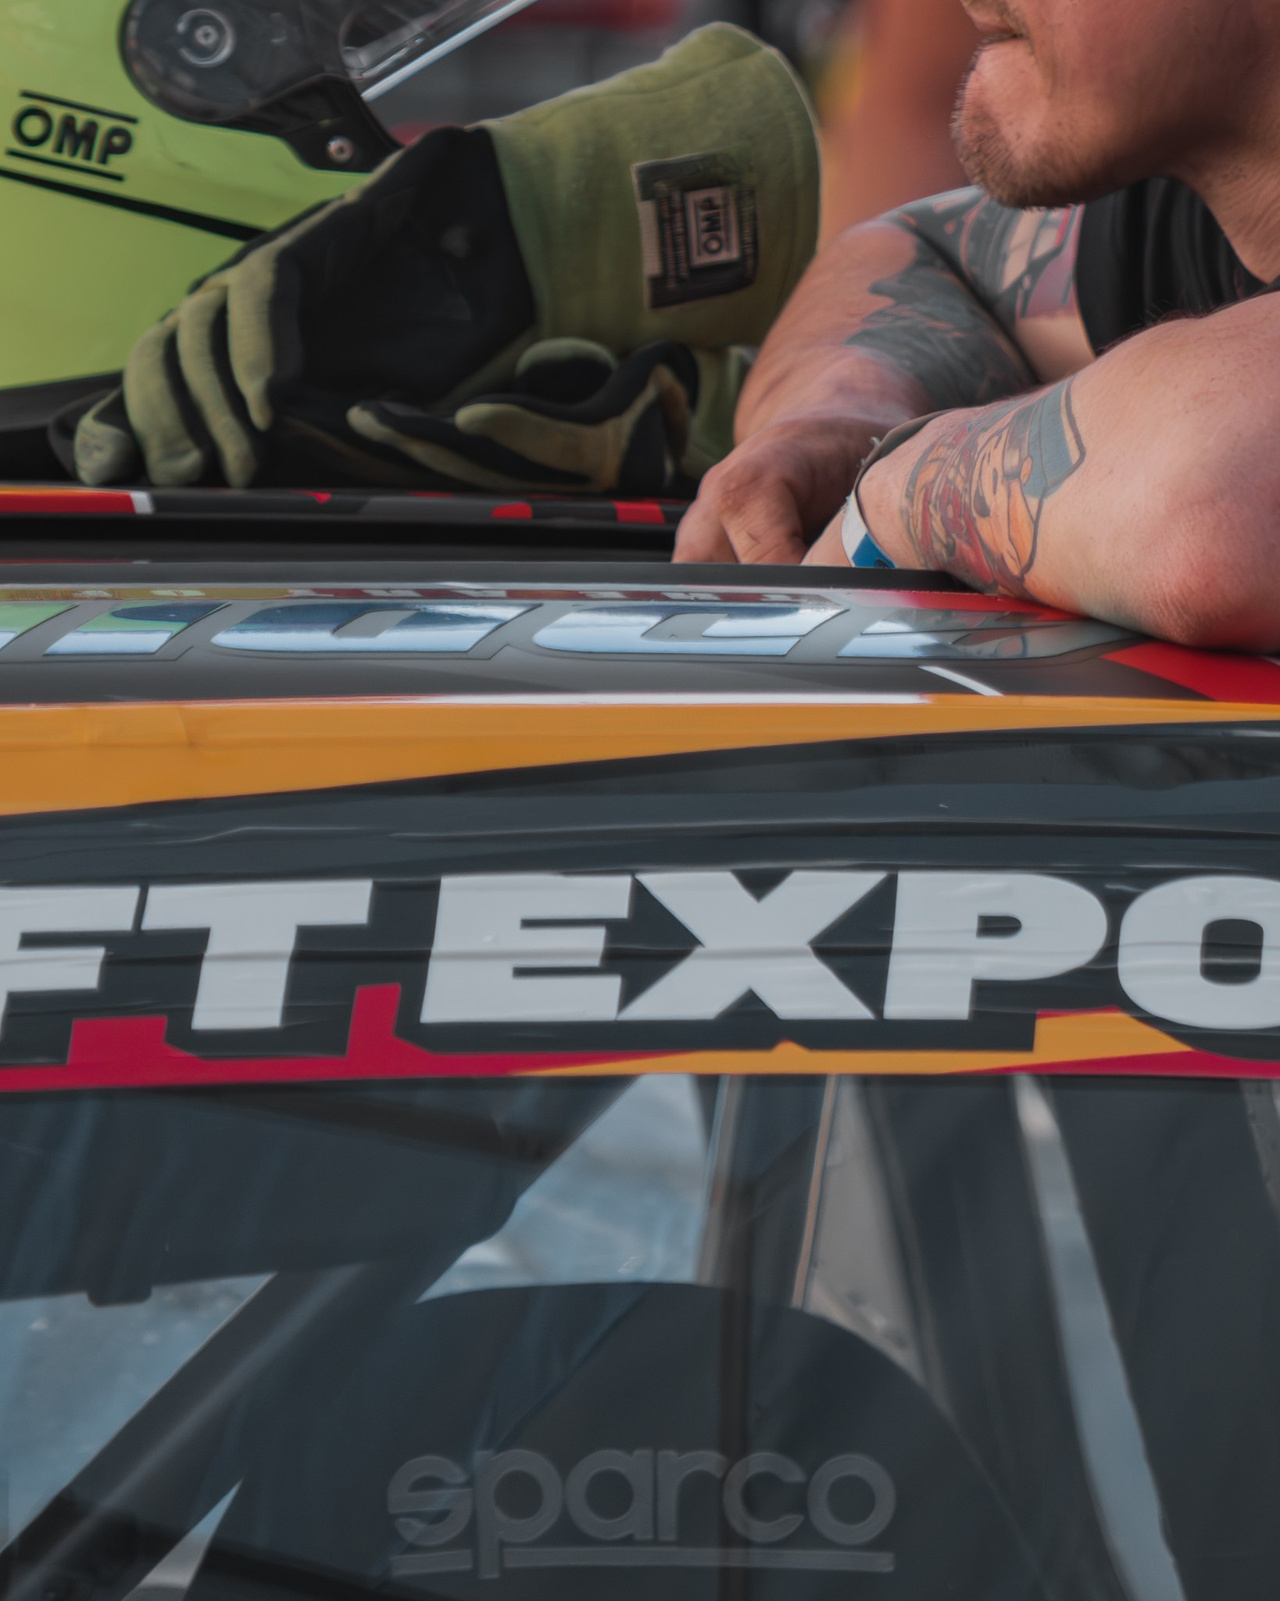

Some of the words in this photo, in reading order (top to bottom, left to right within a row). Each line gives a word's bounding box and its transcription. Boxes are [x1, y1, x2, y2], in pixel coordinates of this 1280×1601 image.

[12, 104, 134, 165] OMP
[699, 197, 724, 256] OMP
[387, 1447, 897, 1580] sparco
